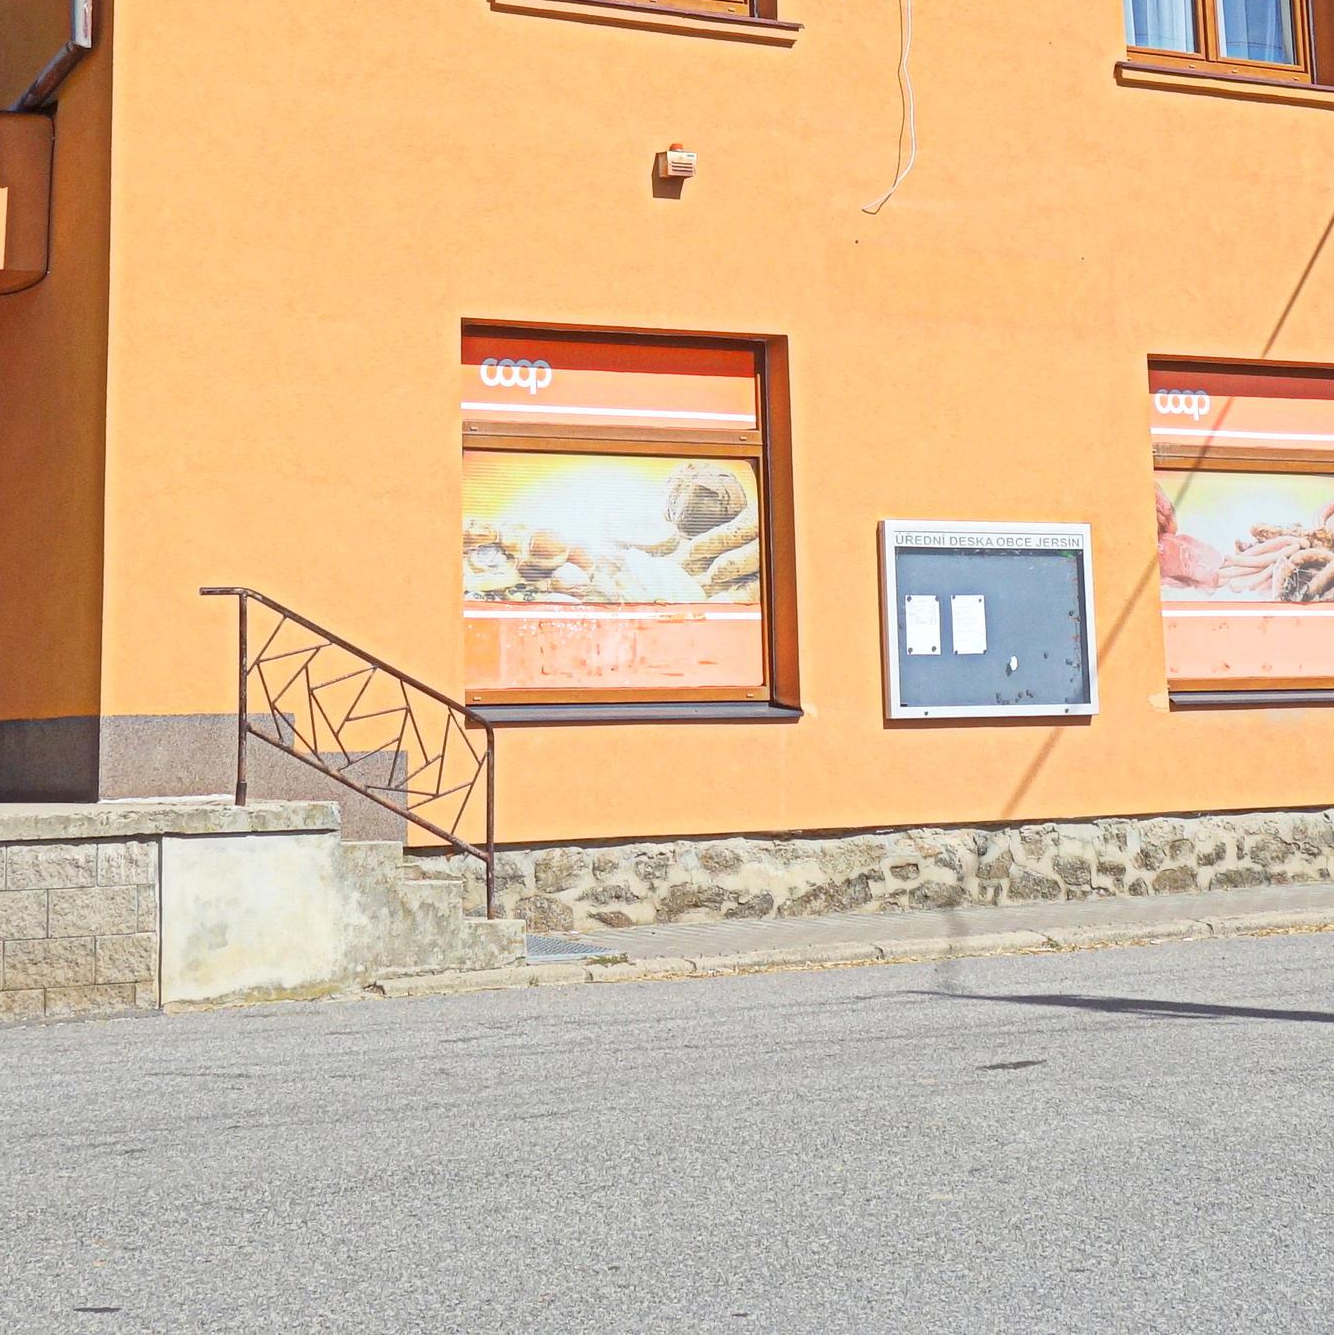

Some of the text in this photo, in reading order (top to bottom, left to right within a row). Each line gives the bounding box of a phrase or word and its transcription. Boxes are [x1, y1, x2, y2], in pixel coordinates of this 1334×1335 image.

[480, 357, 552, 395] coop
[1154, 388, 1211, 421] coop
[895, 532, 945, 546] ÚŘEDNÍ
[949, 536, 993, 547] DESKA
[996, 537, 1032, 547] OBCE
